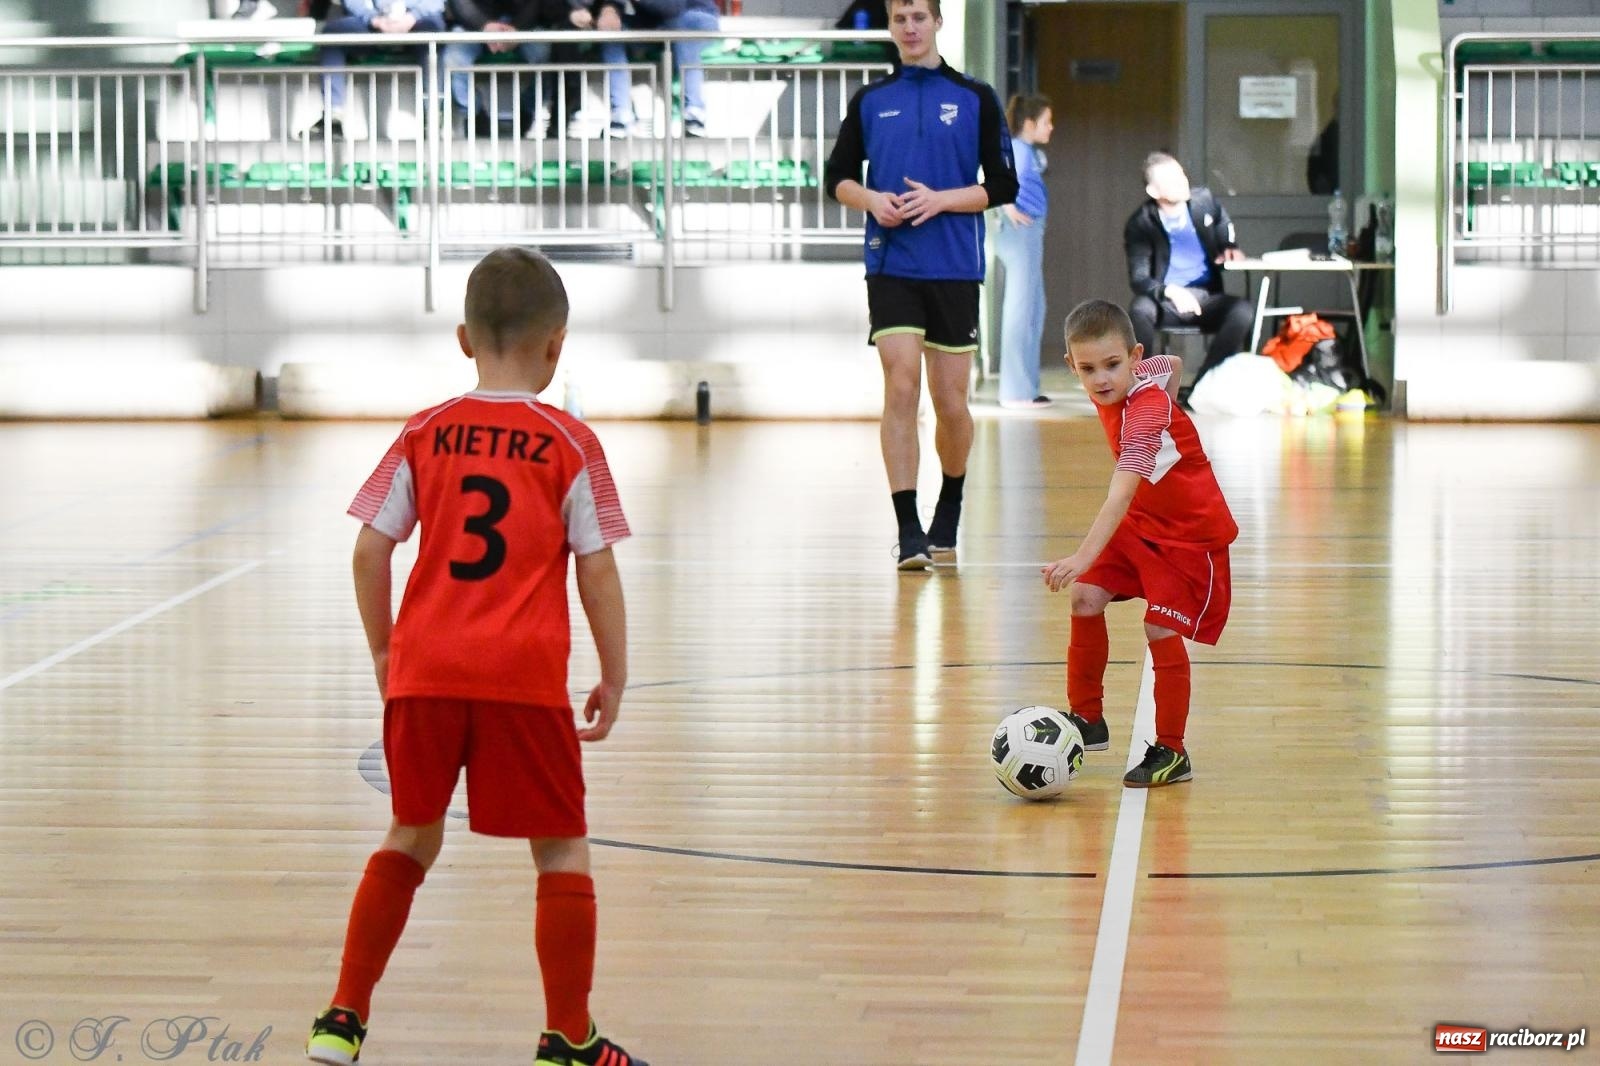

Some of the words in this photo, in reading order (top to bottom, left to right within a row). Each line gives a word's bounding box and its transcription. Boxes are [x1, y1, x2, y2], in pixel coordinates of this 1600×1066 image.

[433, 424, 554, 464] KIETRZ
[449, 474, 511, 582] 3
[1160, 606, 1191, 626] PATRICK
